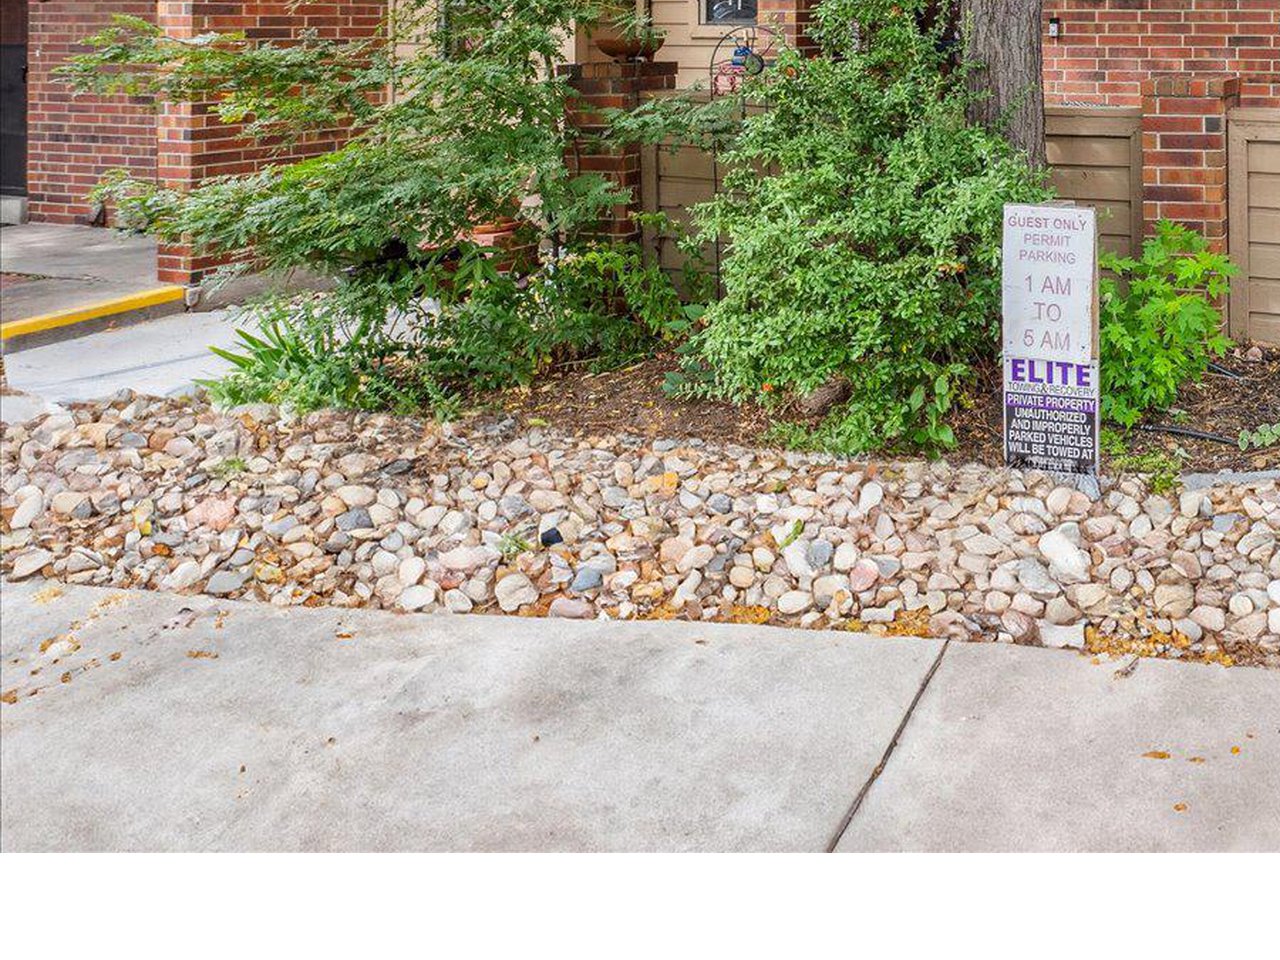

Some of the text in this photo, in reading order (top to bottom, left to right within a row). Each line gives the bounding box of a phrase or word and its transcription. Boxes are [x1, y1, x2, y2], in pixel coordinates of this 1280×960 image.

[1008, 216, 1087, 231] GUEST ONLY
[1024, 234, 1071, 247] PERMIT
[1019, 250, 1076, 265] PARKING
[1025, 275, 1071, 296] 1 AM
[1033, 302, 1061, 322] TO
[1040, 330, 1070, 351] AM
[1011, 358, 1090, 387] ELITE
[1007, 393, 1095, 412] PRIVATE PROPERTY
[1015, 408, 1087, 424] UNAUTHORIZED
[1011, 418, 1091, 436] AND IMPROPERLY
[1009, 429, 1093, 448] PARKED VEHICLES
[1008, 441, 1094, 460] WILL BE TOWED AT
